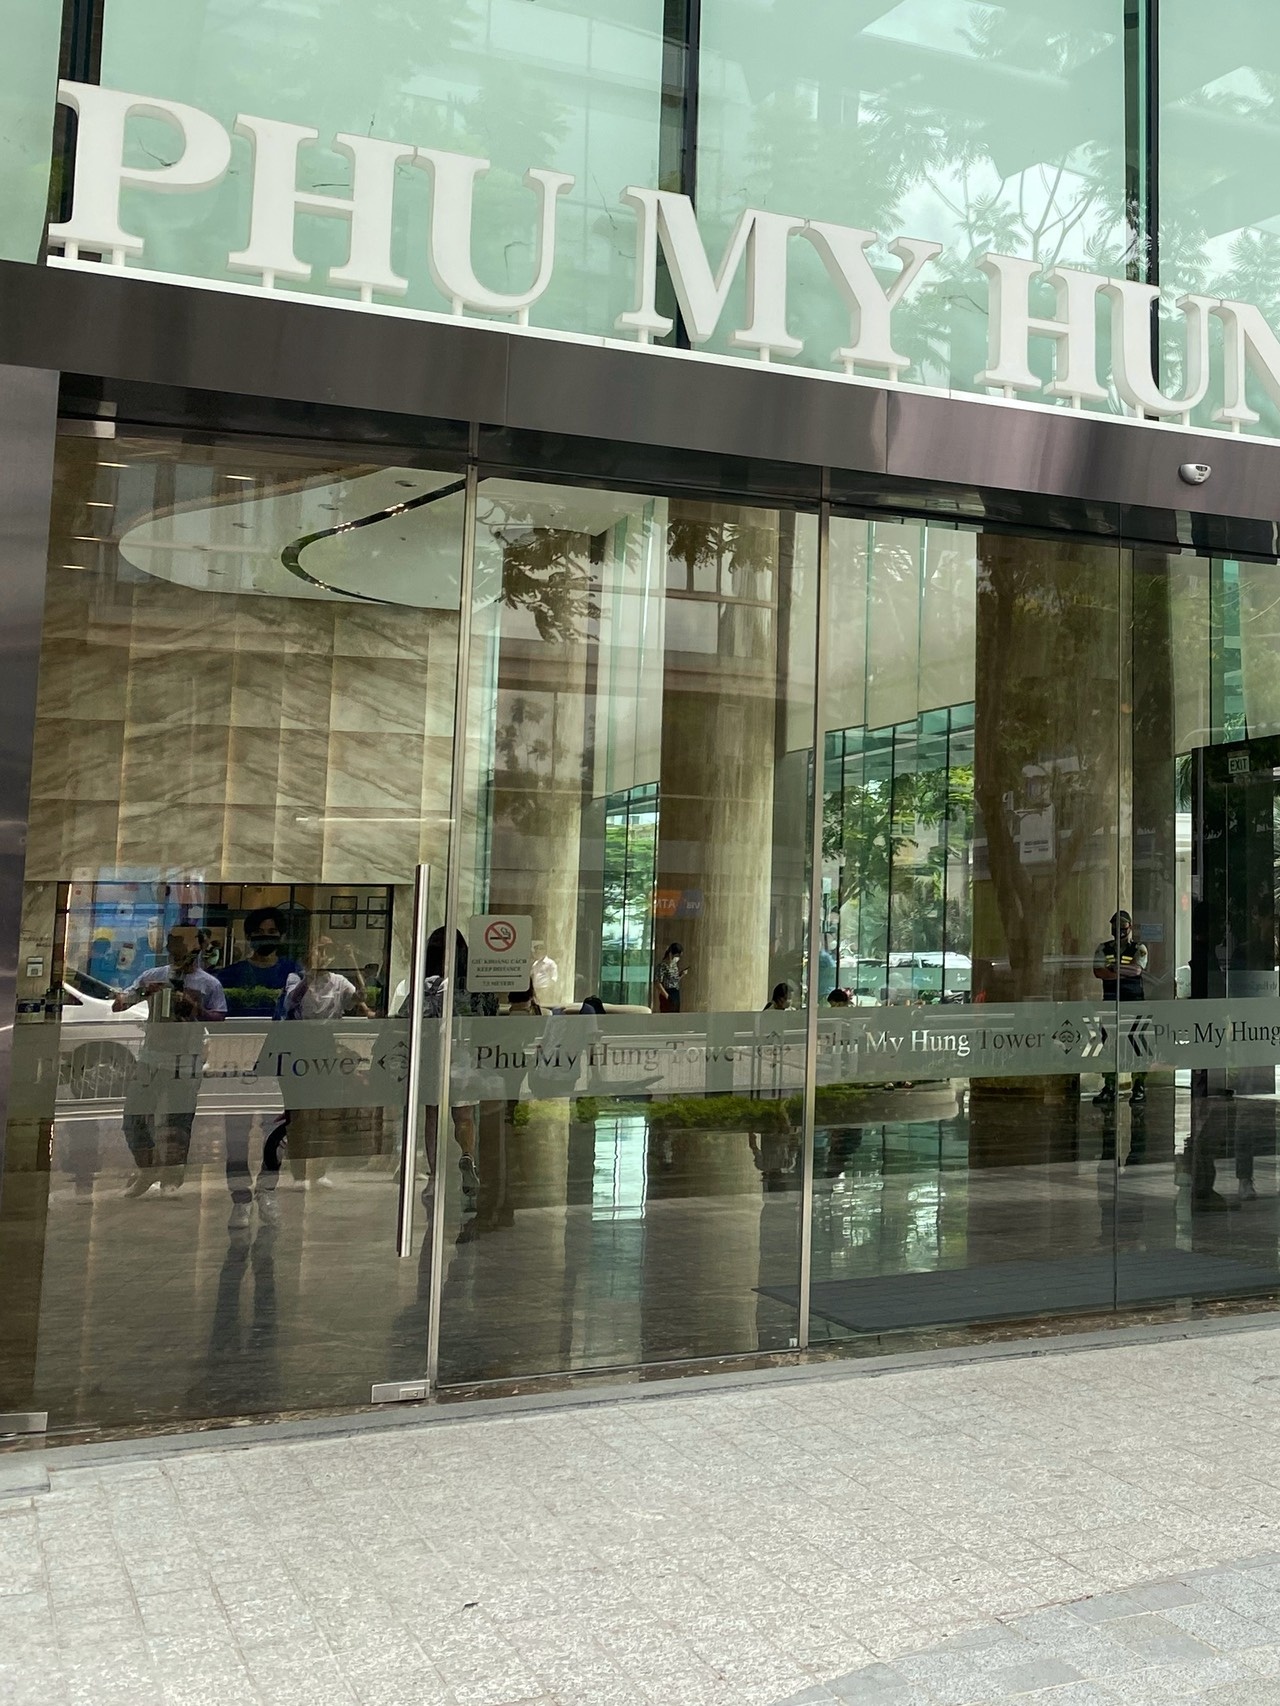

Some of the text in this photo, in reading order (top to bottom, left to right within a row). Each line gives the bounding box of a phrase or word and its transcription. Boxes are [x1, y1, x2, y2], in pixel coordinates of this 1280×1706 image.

[48, 79, 576, 316] PHU
[614, 184, 943, 371] MY
[1230, 758, 1248, 771] EXIT
[865, 1030, 904, 1059] My
[911, 1029, 971, 1057] Hung
[976, 1028, 1046, 1051] Tower
[1193, 1022, 1227, 1049] My
[171, 1052, 258, 1088] Hung
[268, 1050, 368, 1077] Tower
[474, 1040, 744, 1072] Phu My Hung Tower
